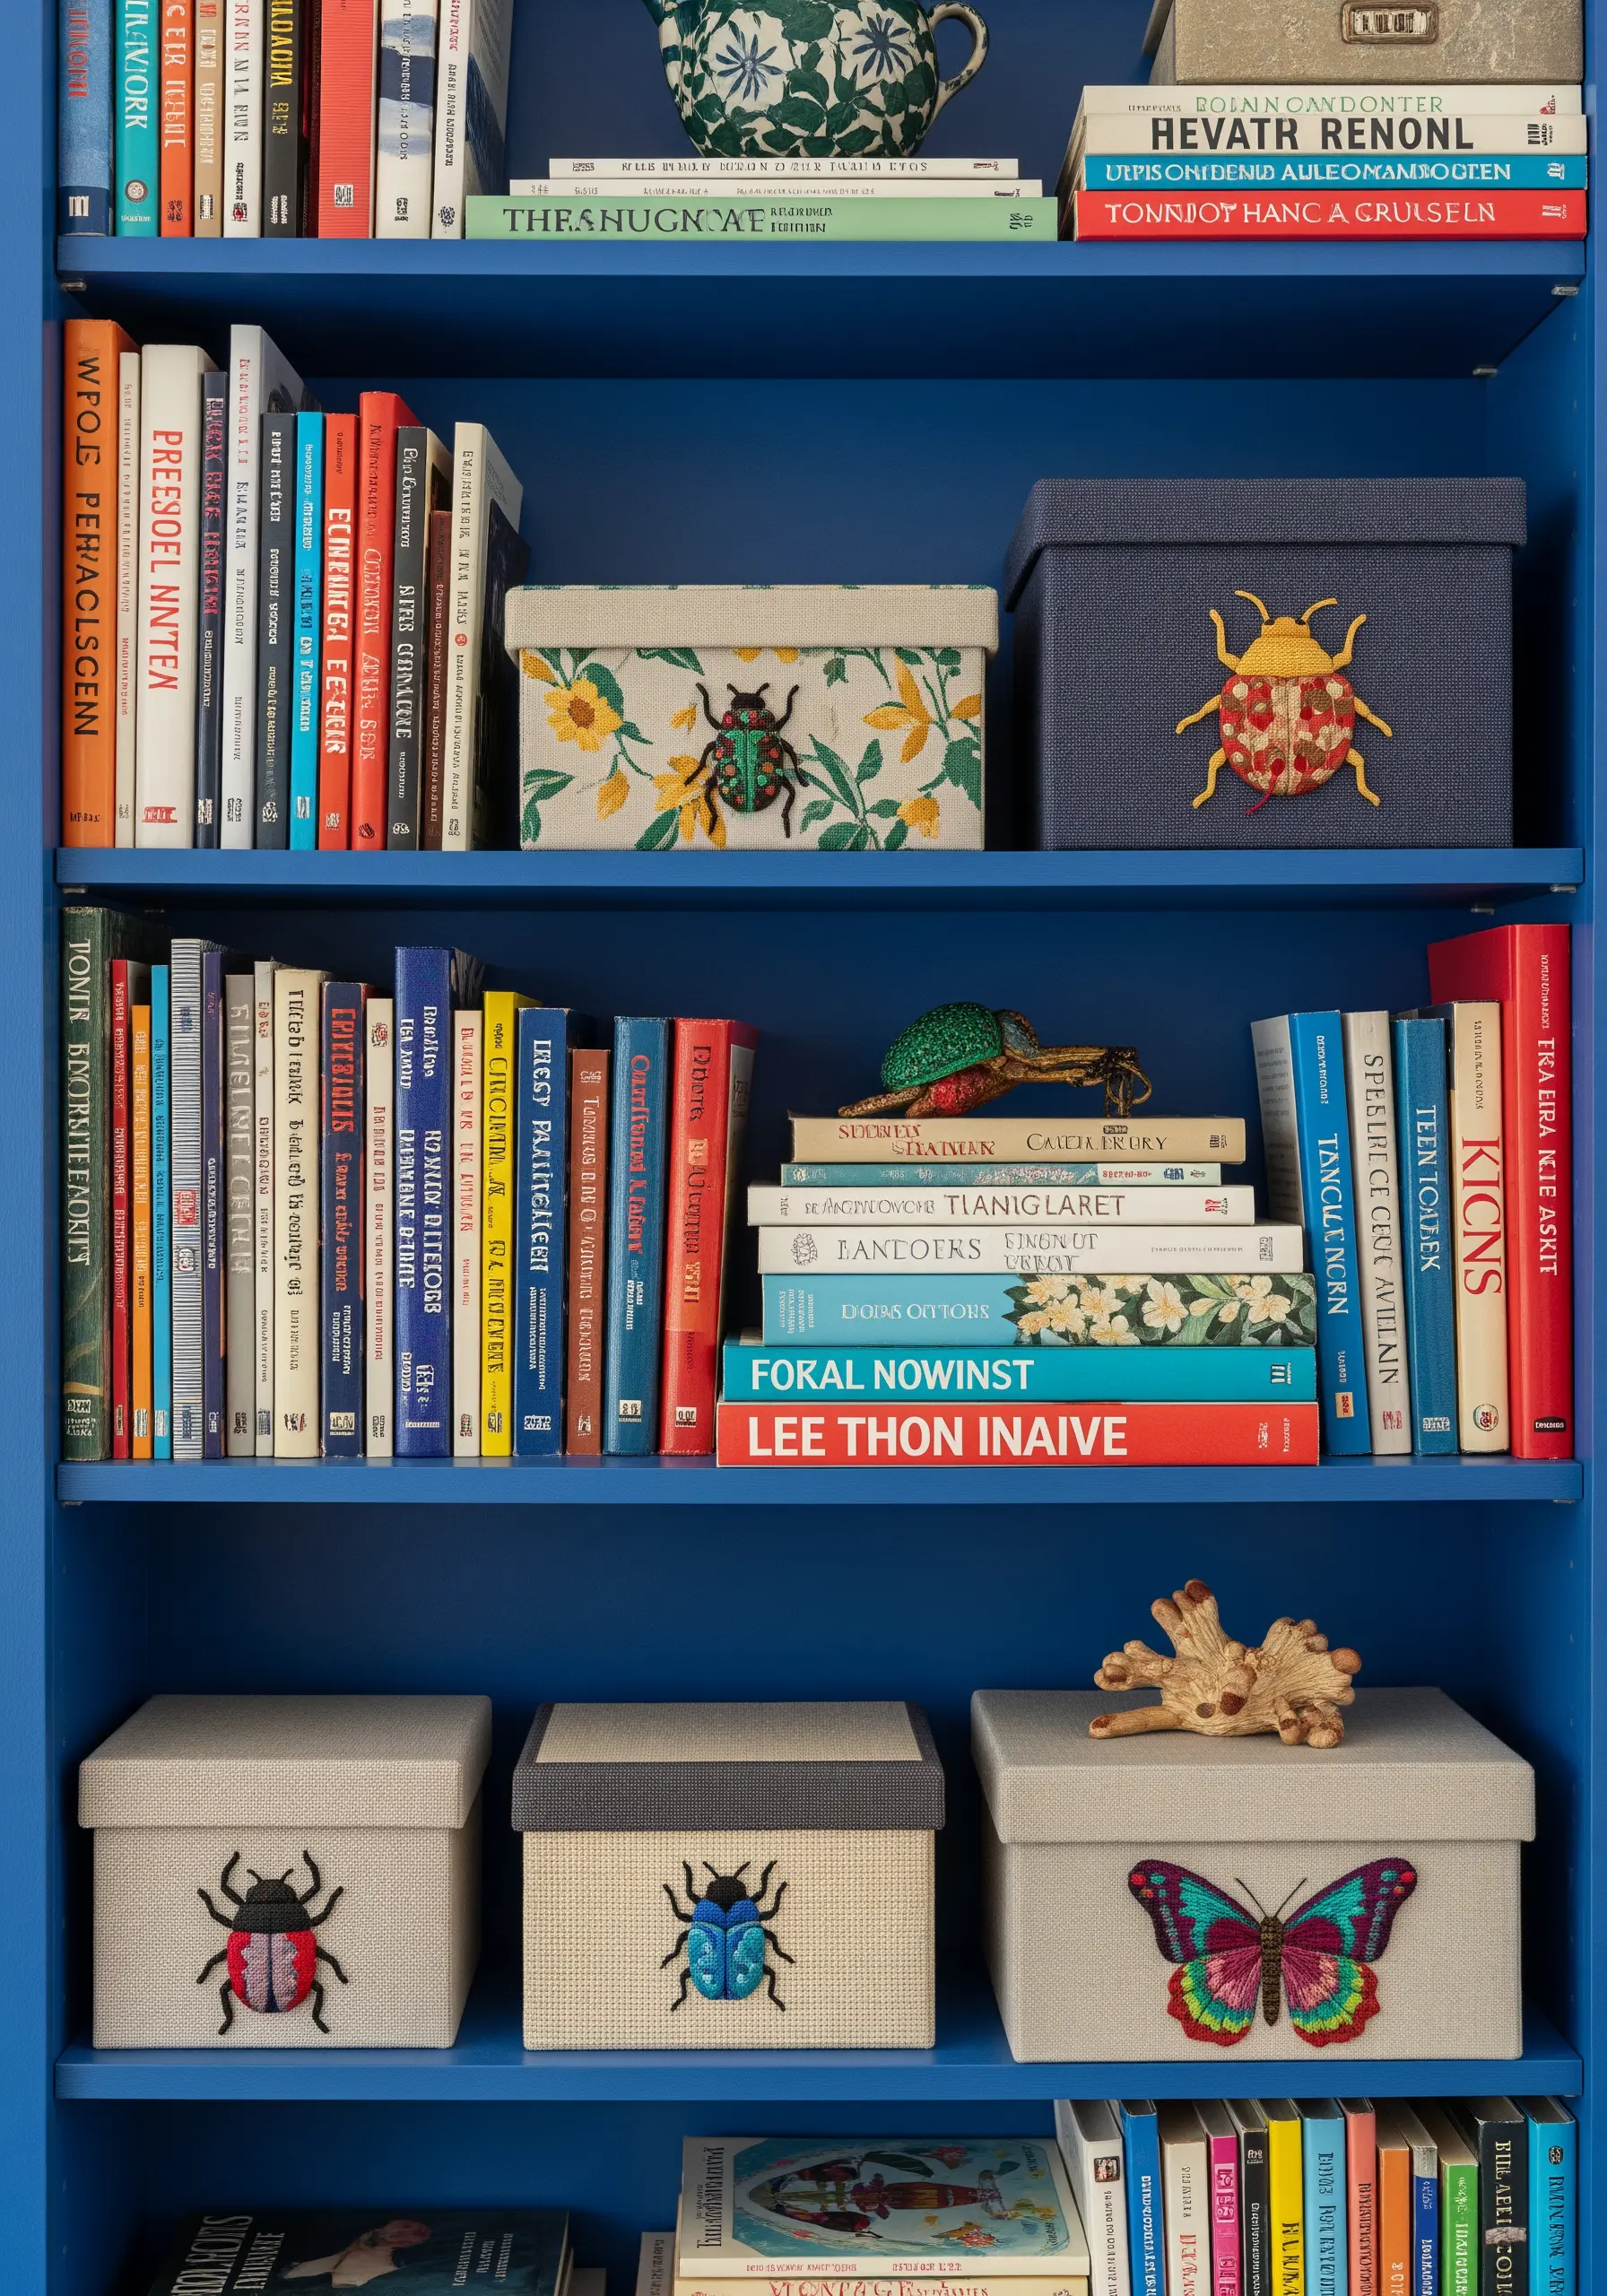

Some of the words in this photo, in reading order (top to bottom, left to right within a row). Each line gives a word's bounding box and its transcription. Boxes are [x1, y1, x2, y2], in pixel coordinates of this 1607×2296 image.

[1151, 117, 1299, 150] HEVATR
[1321, 117, 1473, 150] RENONL
[1416, 1104, 1438, 1167] TEEN
[1461, 1135, 1503, 1296] KICNS
[873, 1359, 1035, 1390] NOWINST
[749, 1416, 826, 1456] LEE
[837, 1416, 963, 1457] THON
[979, 1416, 1128, 1456] INAIVE
